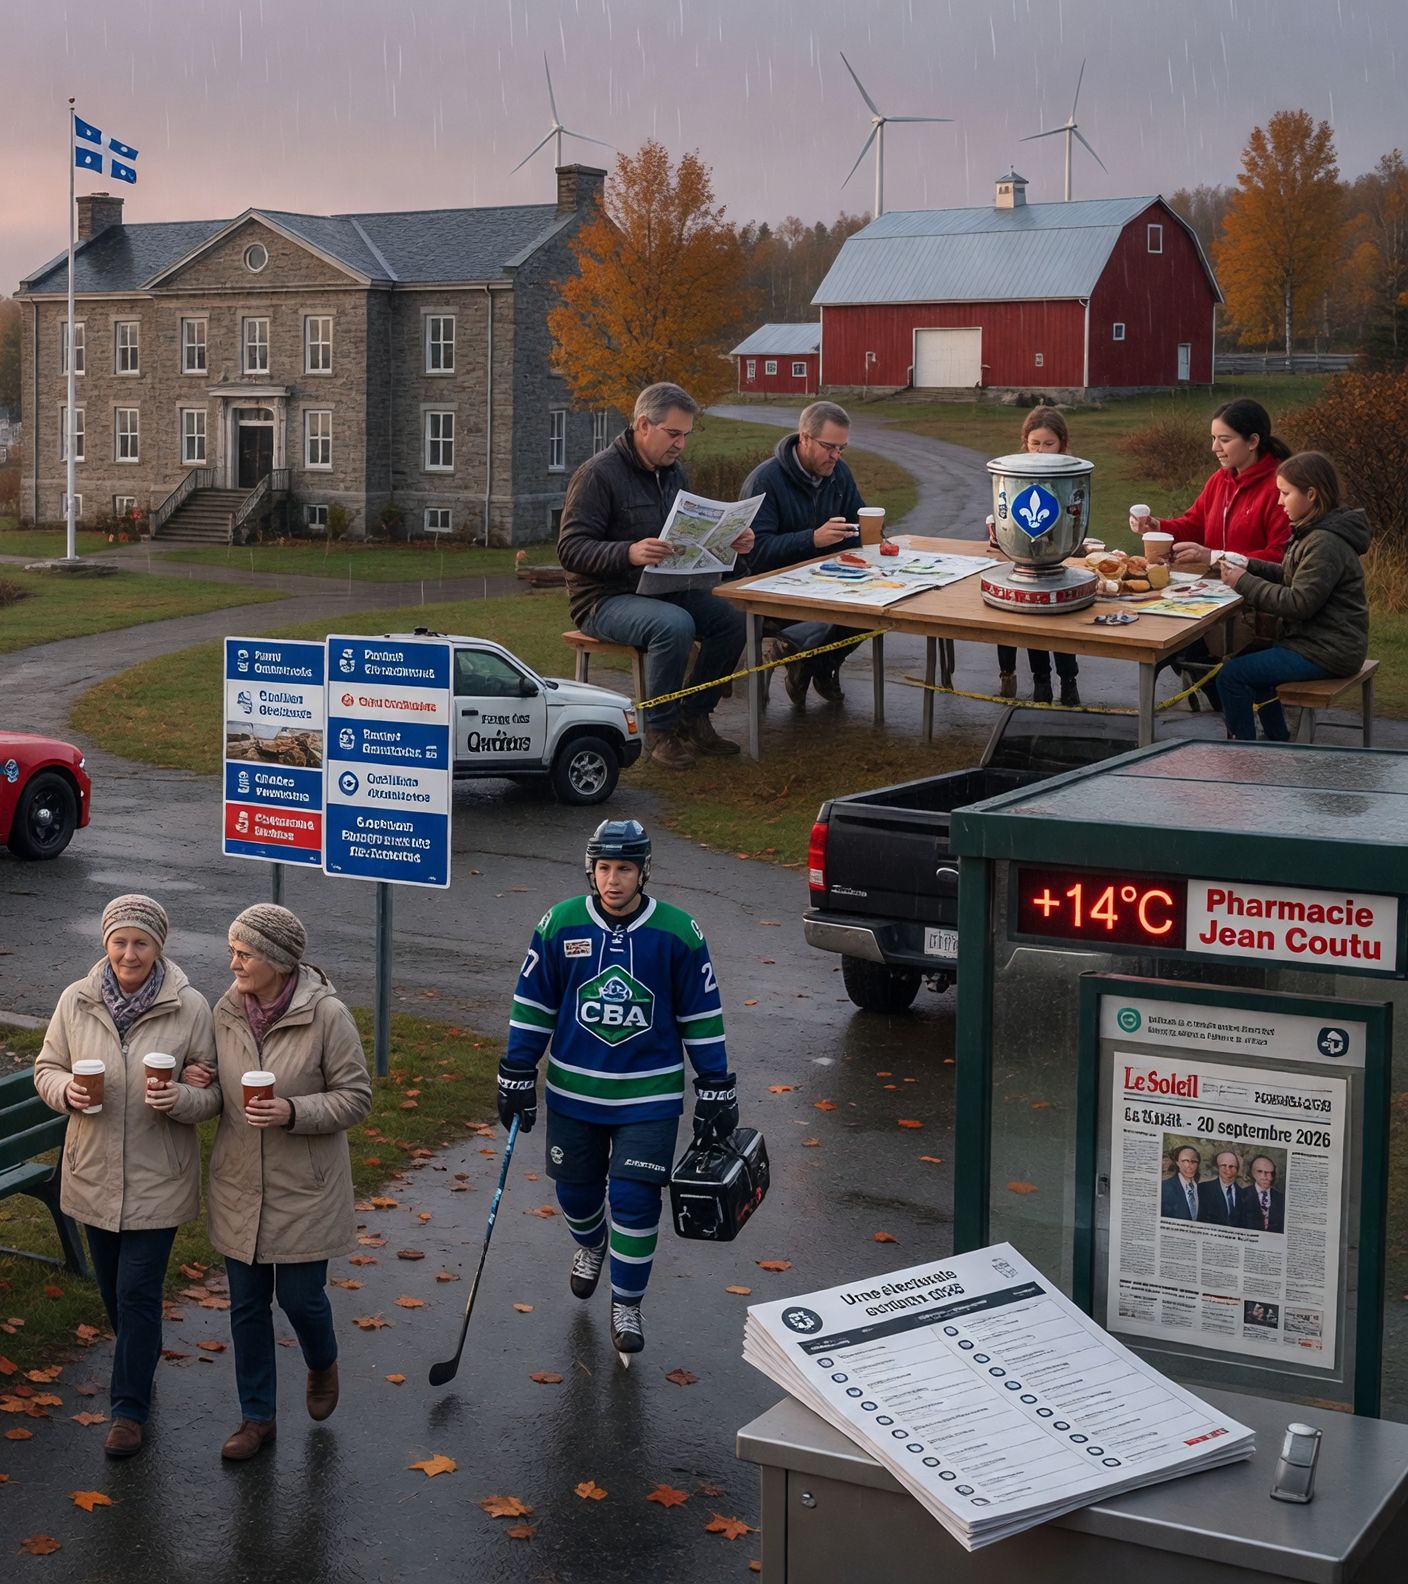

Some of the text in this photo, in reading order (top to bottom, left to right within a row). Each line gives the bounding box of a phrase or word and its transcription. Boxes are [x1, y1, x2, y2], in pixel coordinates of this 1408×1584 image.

[1033, 883, 1174, 935] +14°C
[1206, 888, 1374, 928] Pharmacie
[1199, 920, 1382, 960] Jean Coutu
[580, 1001, 649, 1027] CBA
[1147, 1070, 1199, 1098] Soleil
[1197, 1116, 1214, 1133] 20
[1217, 1121, 1292, 1143] septembre
[1296, 1128, 1331, 1148] 2026
